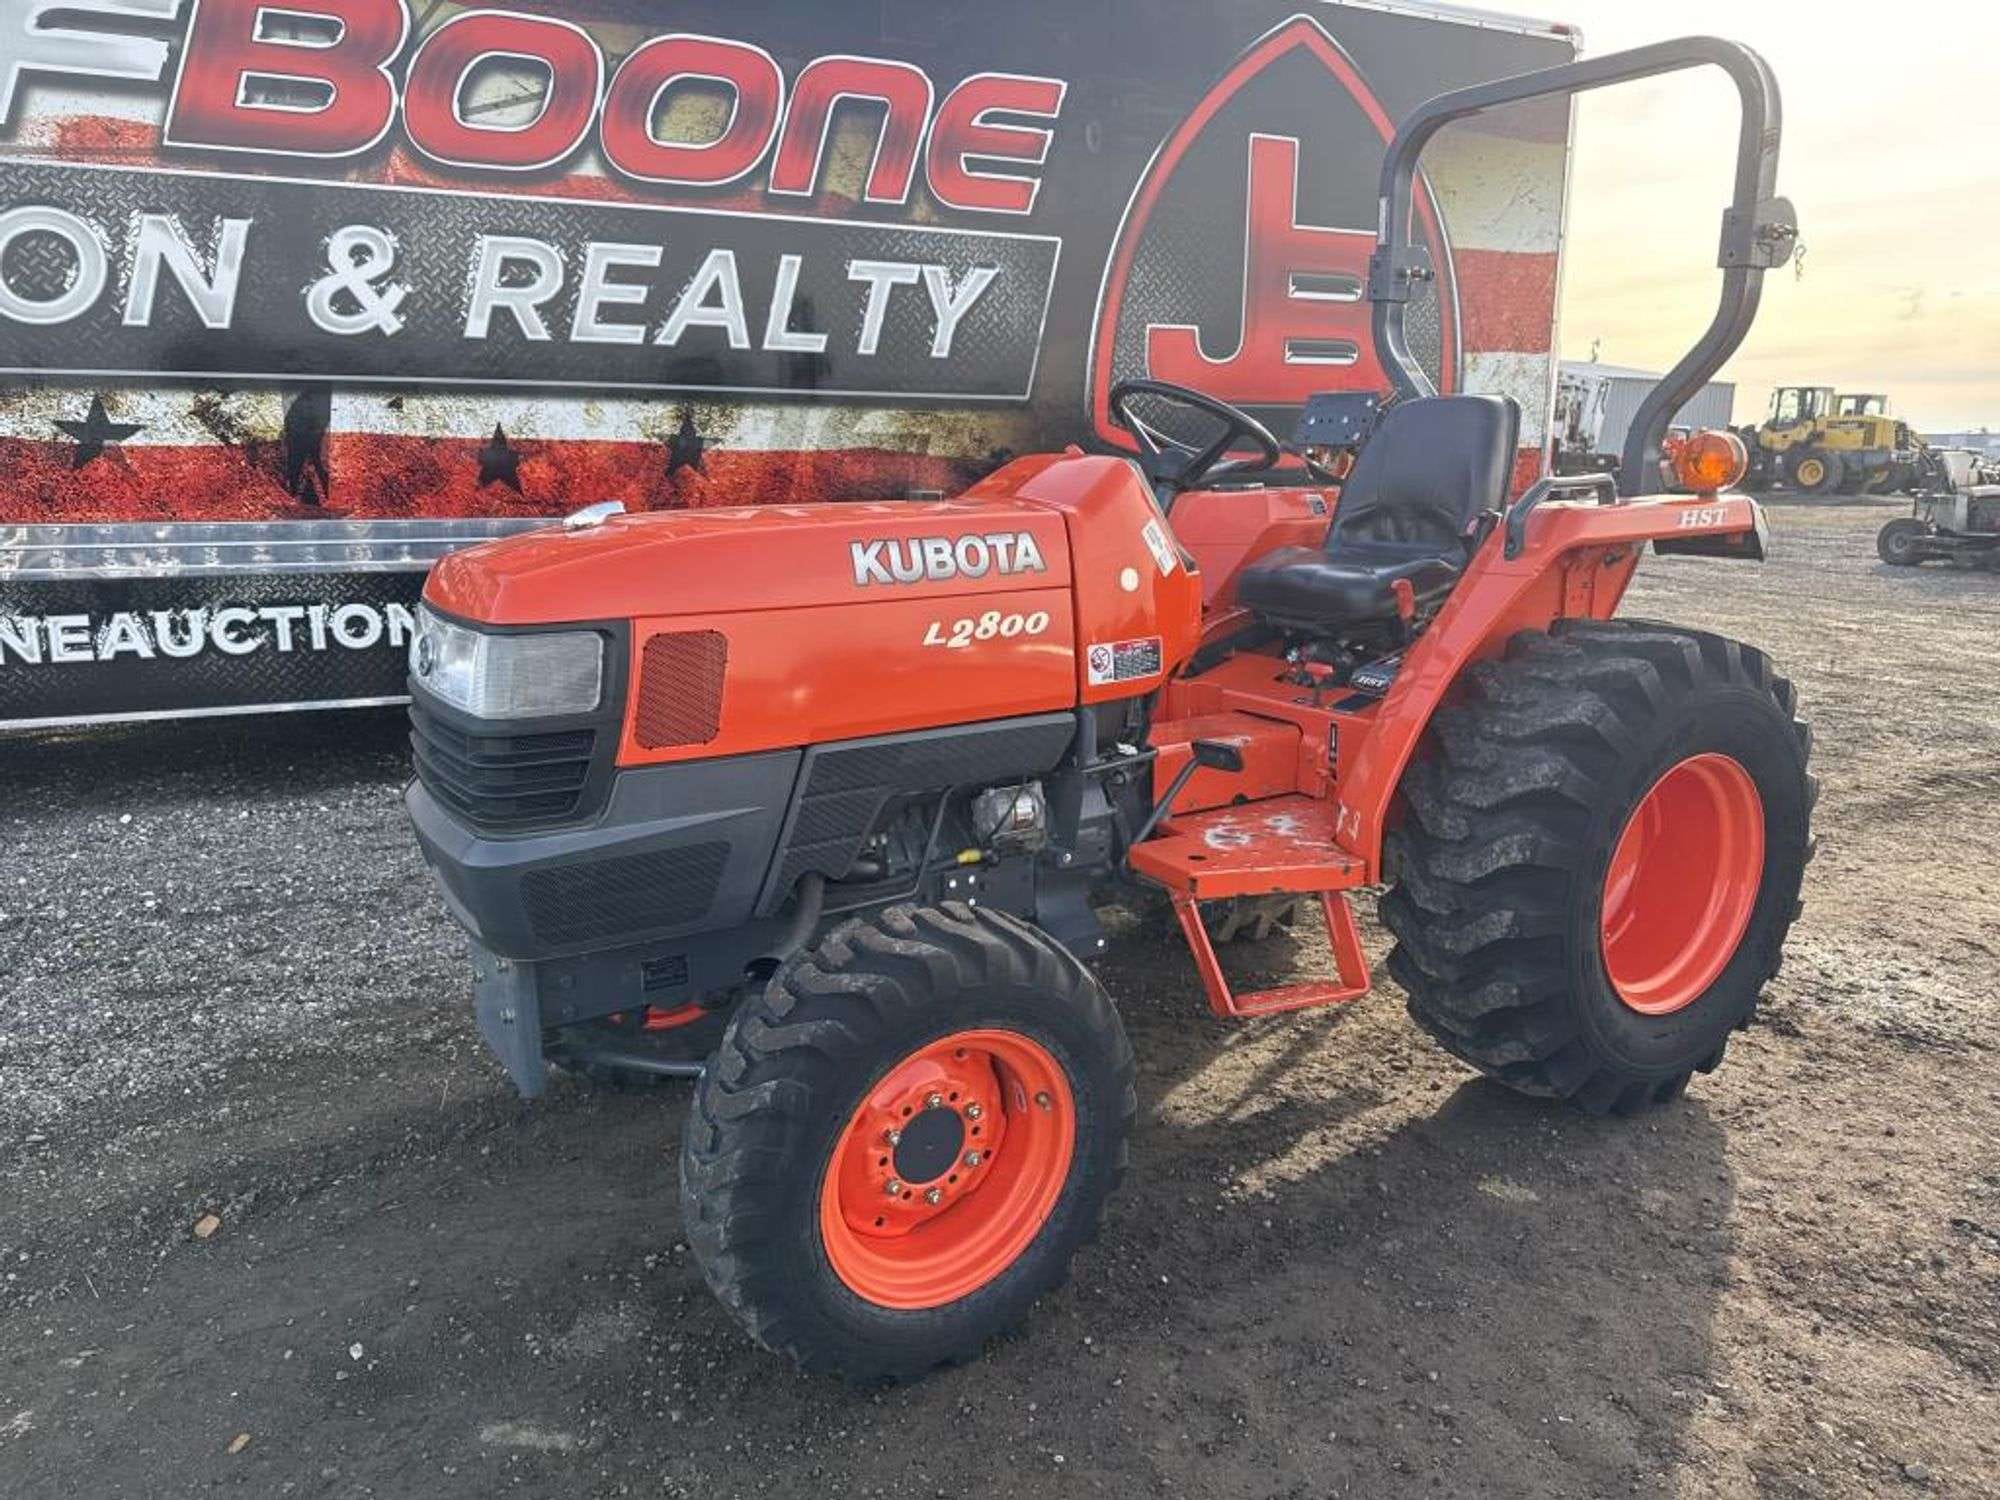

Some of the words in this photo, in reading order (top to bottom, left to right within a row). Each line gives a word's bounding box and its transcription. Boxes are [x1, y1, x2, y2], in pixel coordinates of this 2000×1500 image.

[306, 223, 405, 336] &
[463, 233, 1000, 358] REALTY
[1678, 507, 1726, 529] HST
[849, 531, 1048, 587] KUBOTA
[922, 610, 1050, 648] L2800
